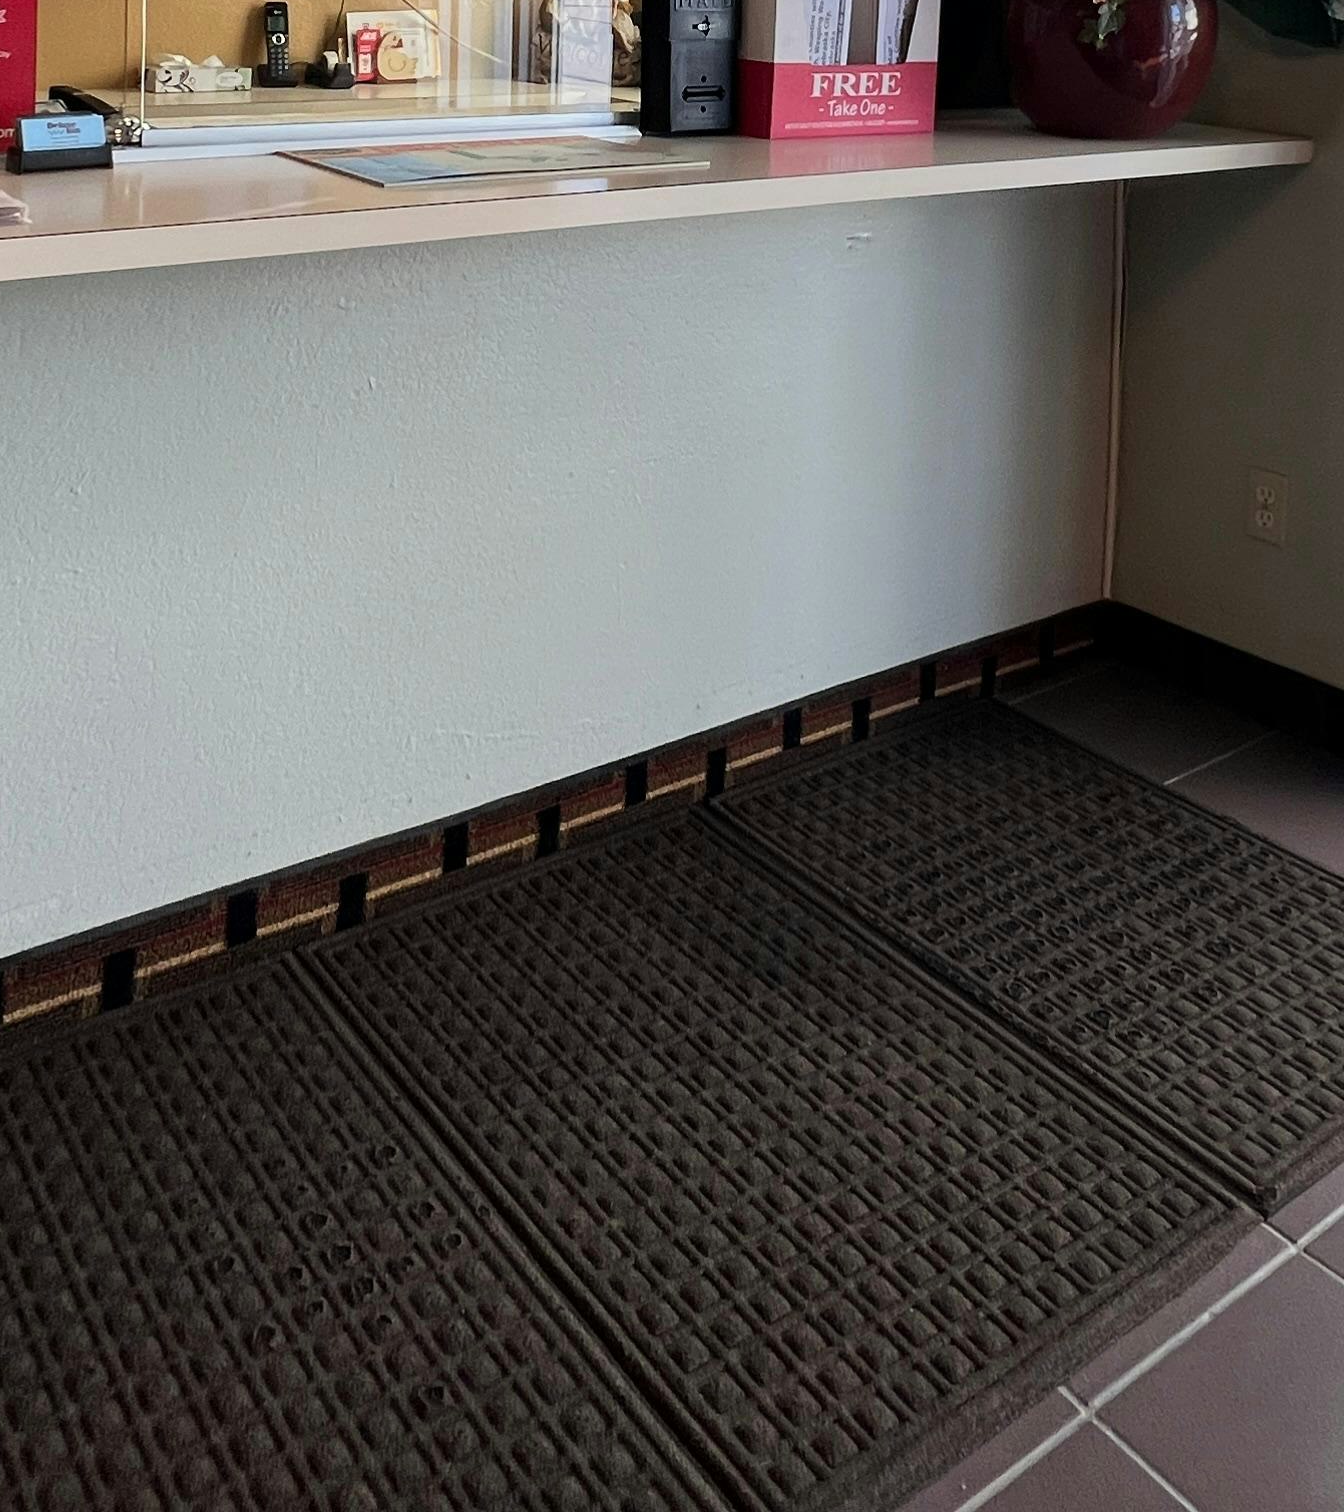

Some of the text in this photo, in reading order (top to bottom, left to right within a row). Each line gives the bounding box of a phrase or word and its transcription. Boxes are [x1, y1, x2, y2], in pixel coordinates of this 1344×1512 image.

[810, 72, 901, 98] FREE
[828, 99, 886, 116] Take One
